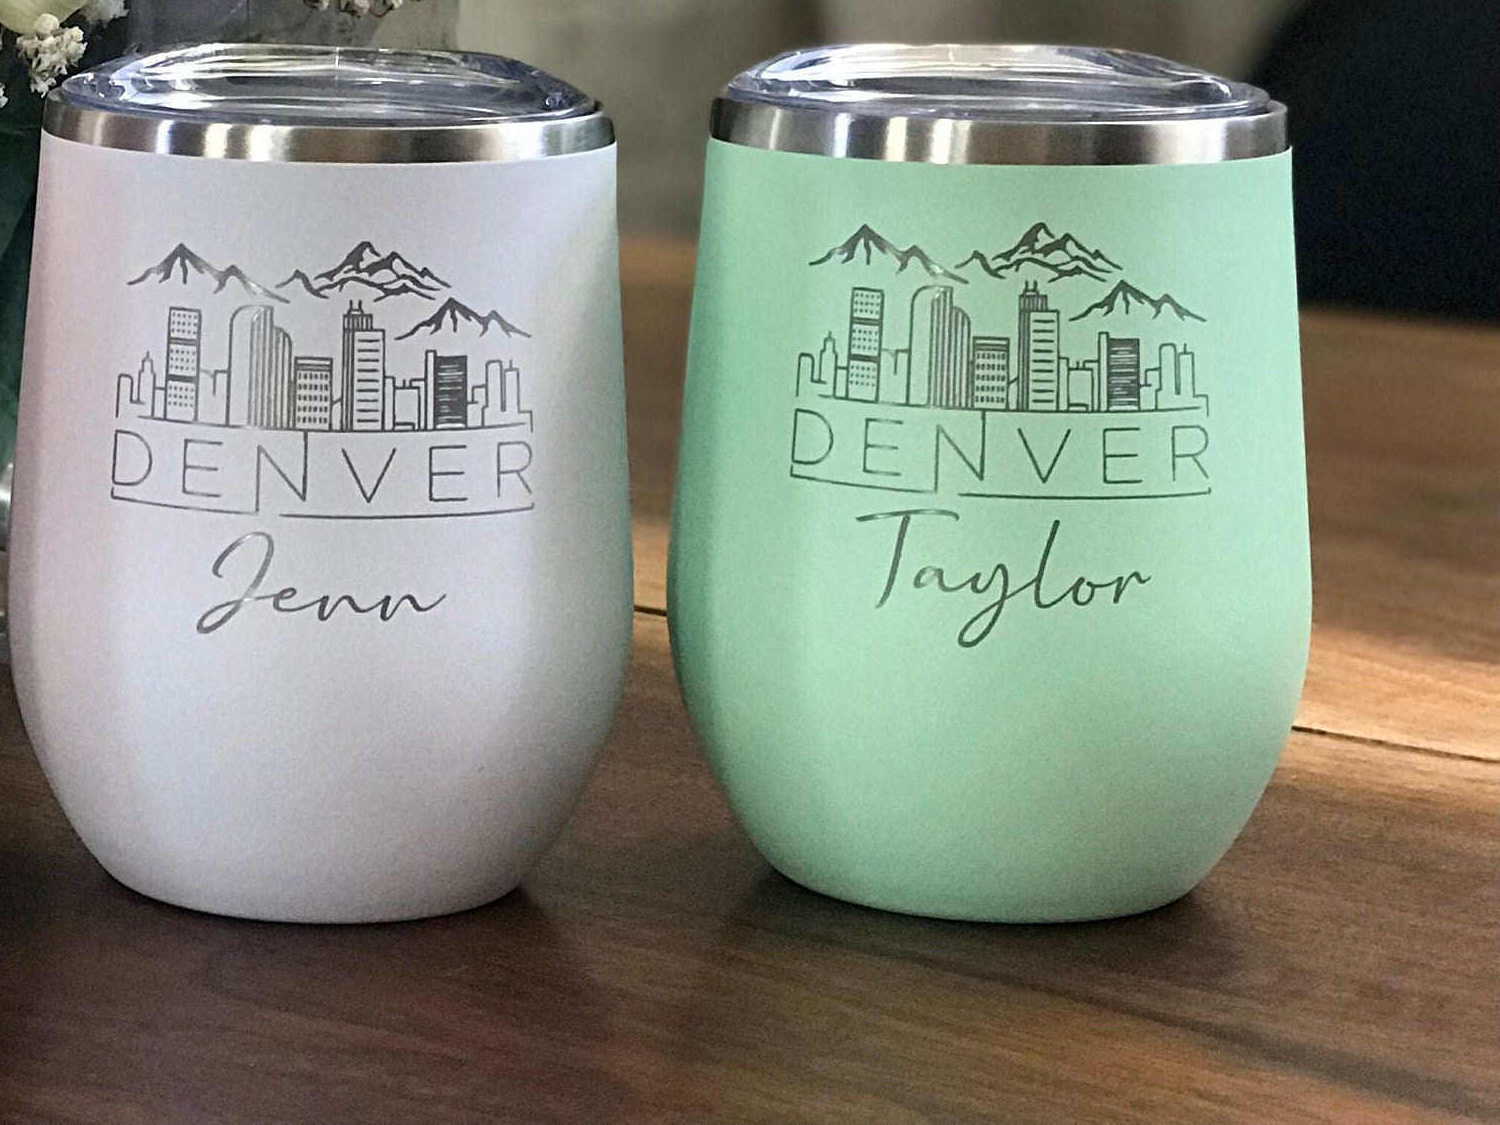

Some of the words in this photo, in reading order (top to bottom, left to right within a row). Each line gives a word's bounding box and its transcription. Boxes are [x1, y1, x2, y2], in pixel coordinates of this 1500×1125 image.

[111, 429, 534, 514] DENVER
[791, 408, 1210, 493] DENVER
[195, 531, 448, 635] Jenn
[855, 507, 1152, 648] Taylor
